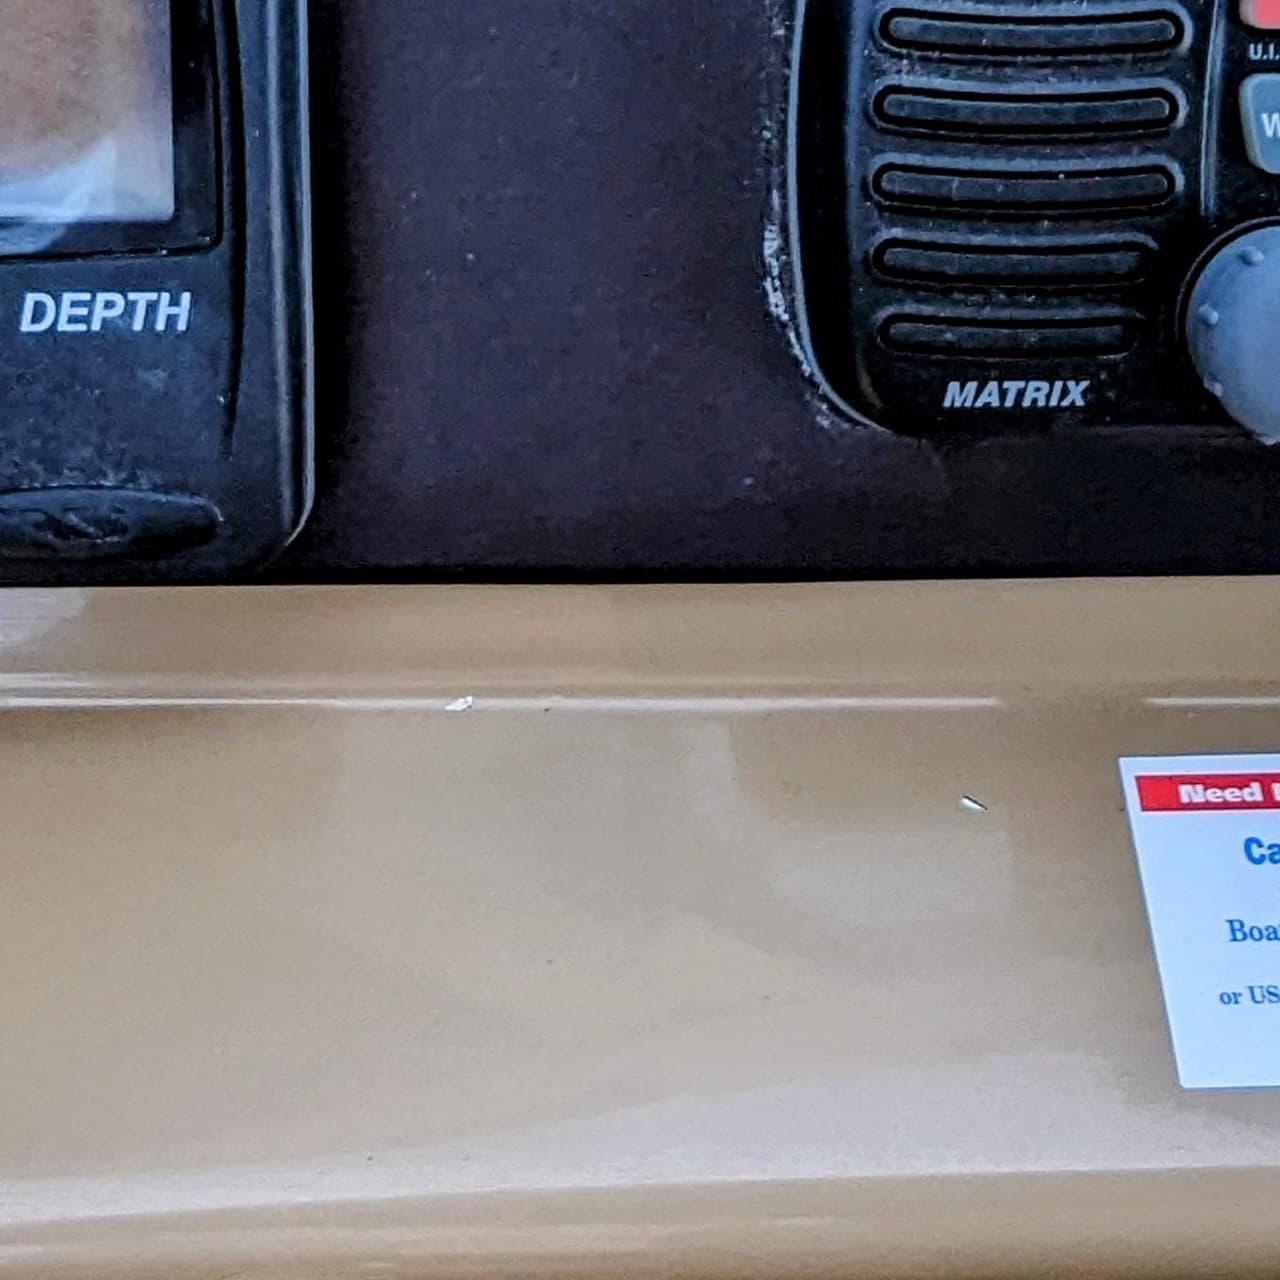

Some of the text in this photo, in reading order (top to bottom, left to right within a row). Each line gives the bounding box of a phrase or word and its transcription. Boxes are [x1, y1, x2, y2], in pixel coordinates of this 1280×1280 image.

[20, 291, 192, 333] DEPTH
[943, 381, 1090, 408] MATRIX
[1178, 783, 1264, 803] Need
[1219, 991, 1242, 1005] or
